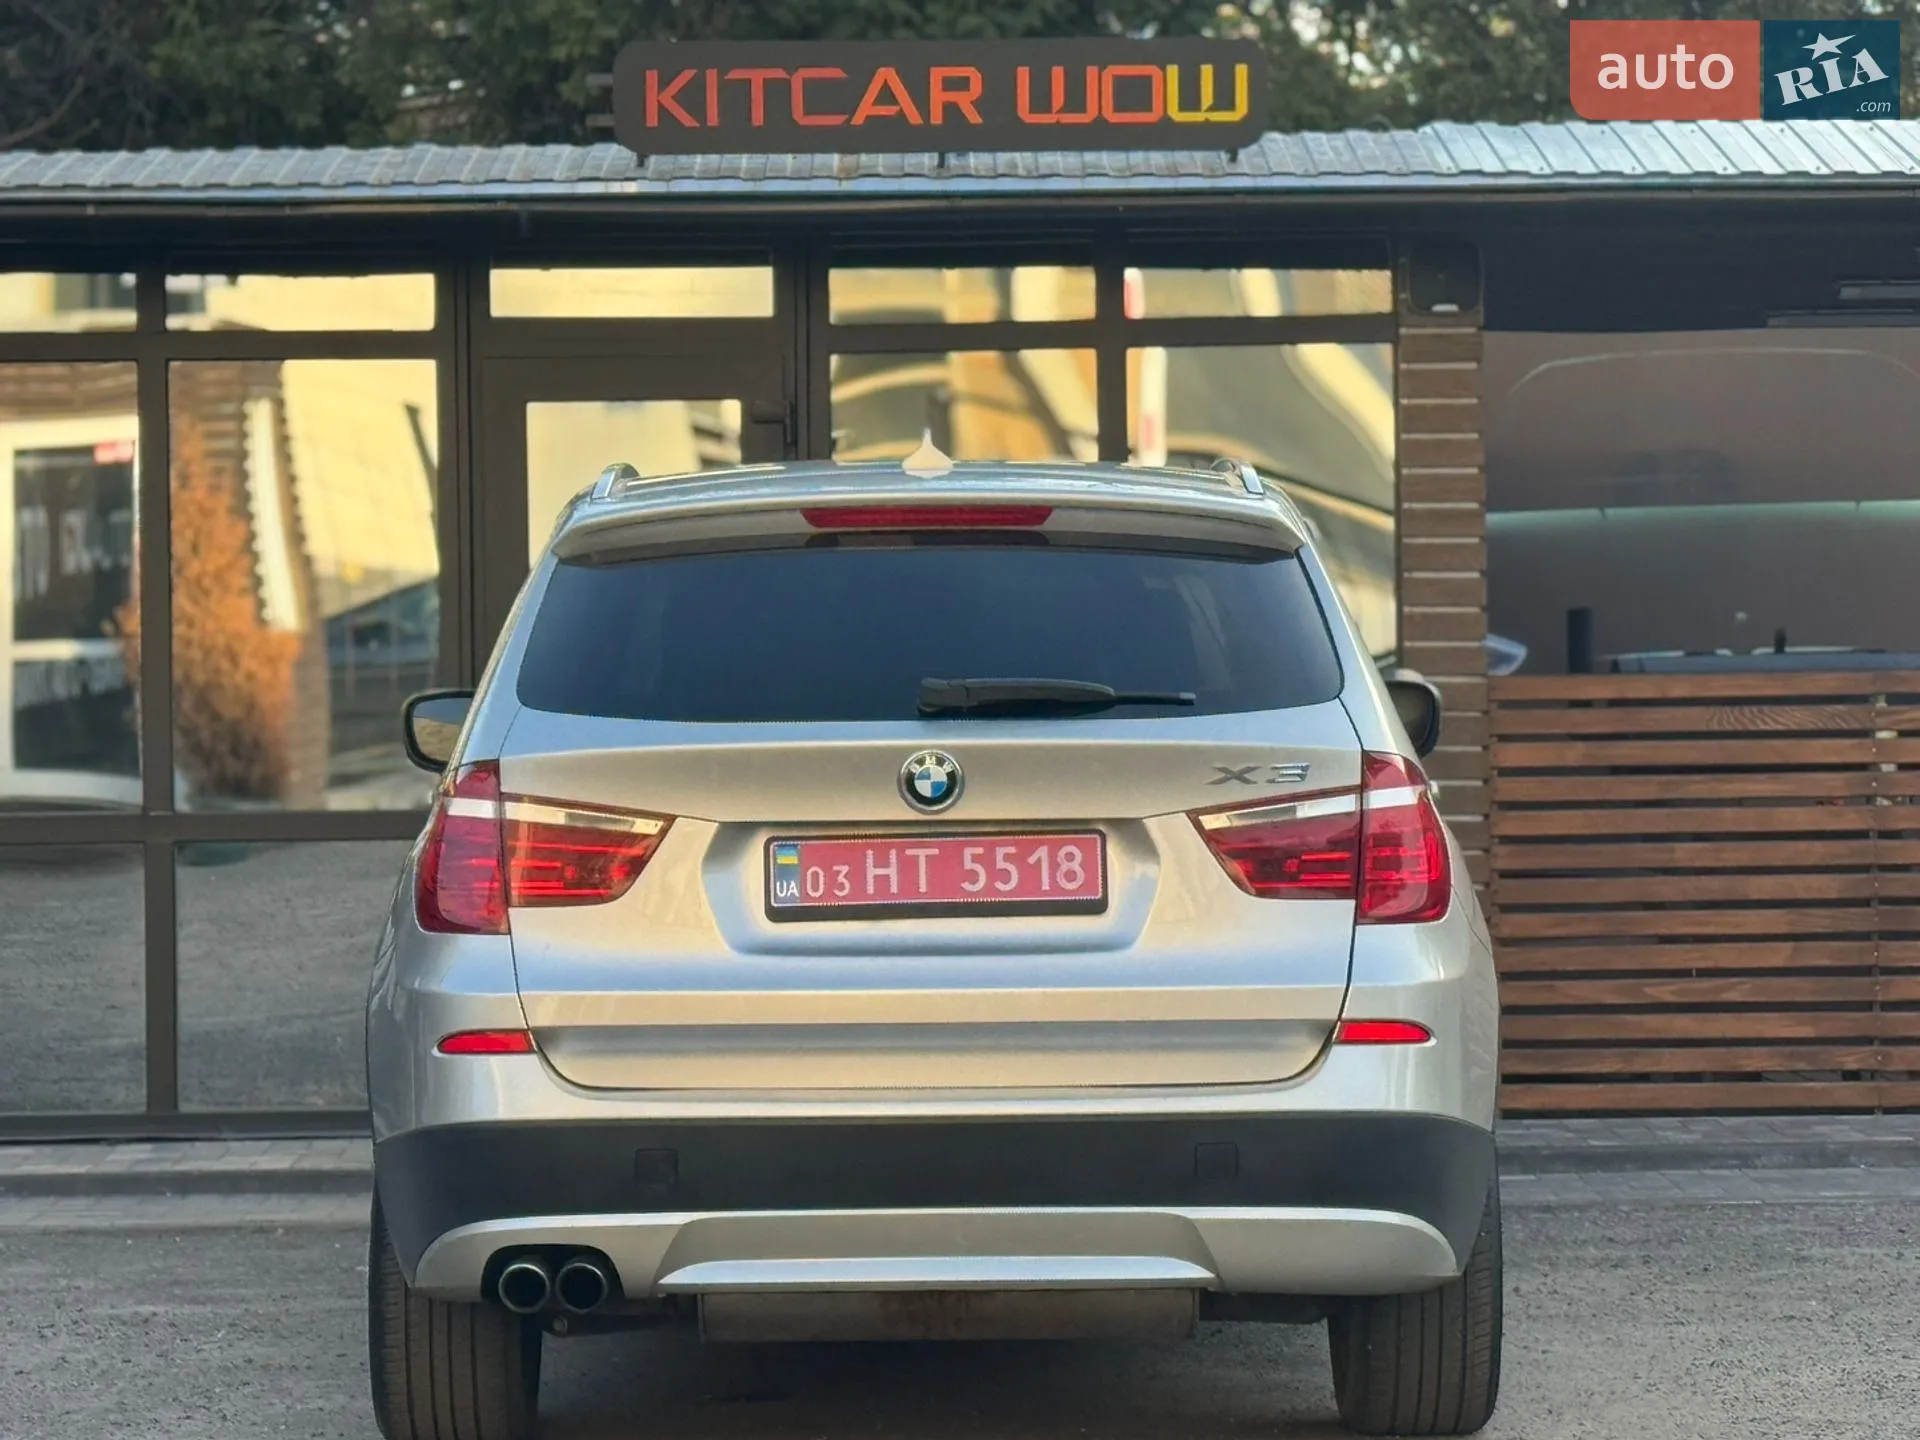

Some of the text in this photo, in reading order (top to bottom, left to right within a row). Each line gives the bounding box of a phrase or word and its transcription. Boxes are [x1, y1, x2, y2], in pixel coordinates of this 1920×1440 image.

[644, 63, 1248, 128] KITCAR WOW
[1204, 762, 1311, 786] X3
[776, 880, 800, 897] UA
[806, 844, 1086, 898] 03 HT 5518
